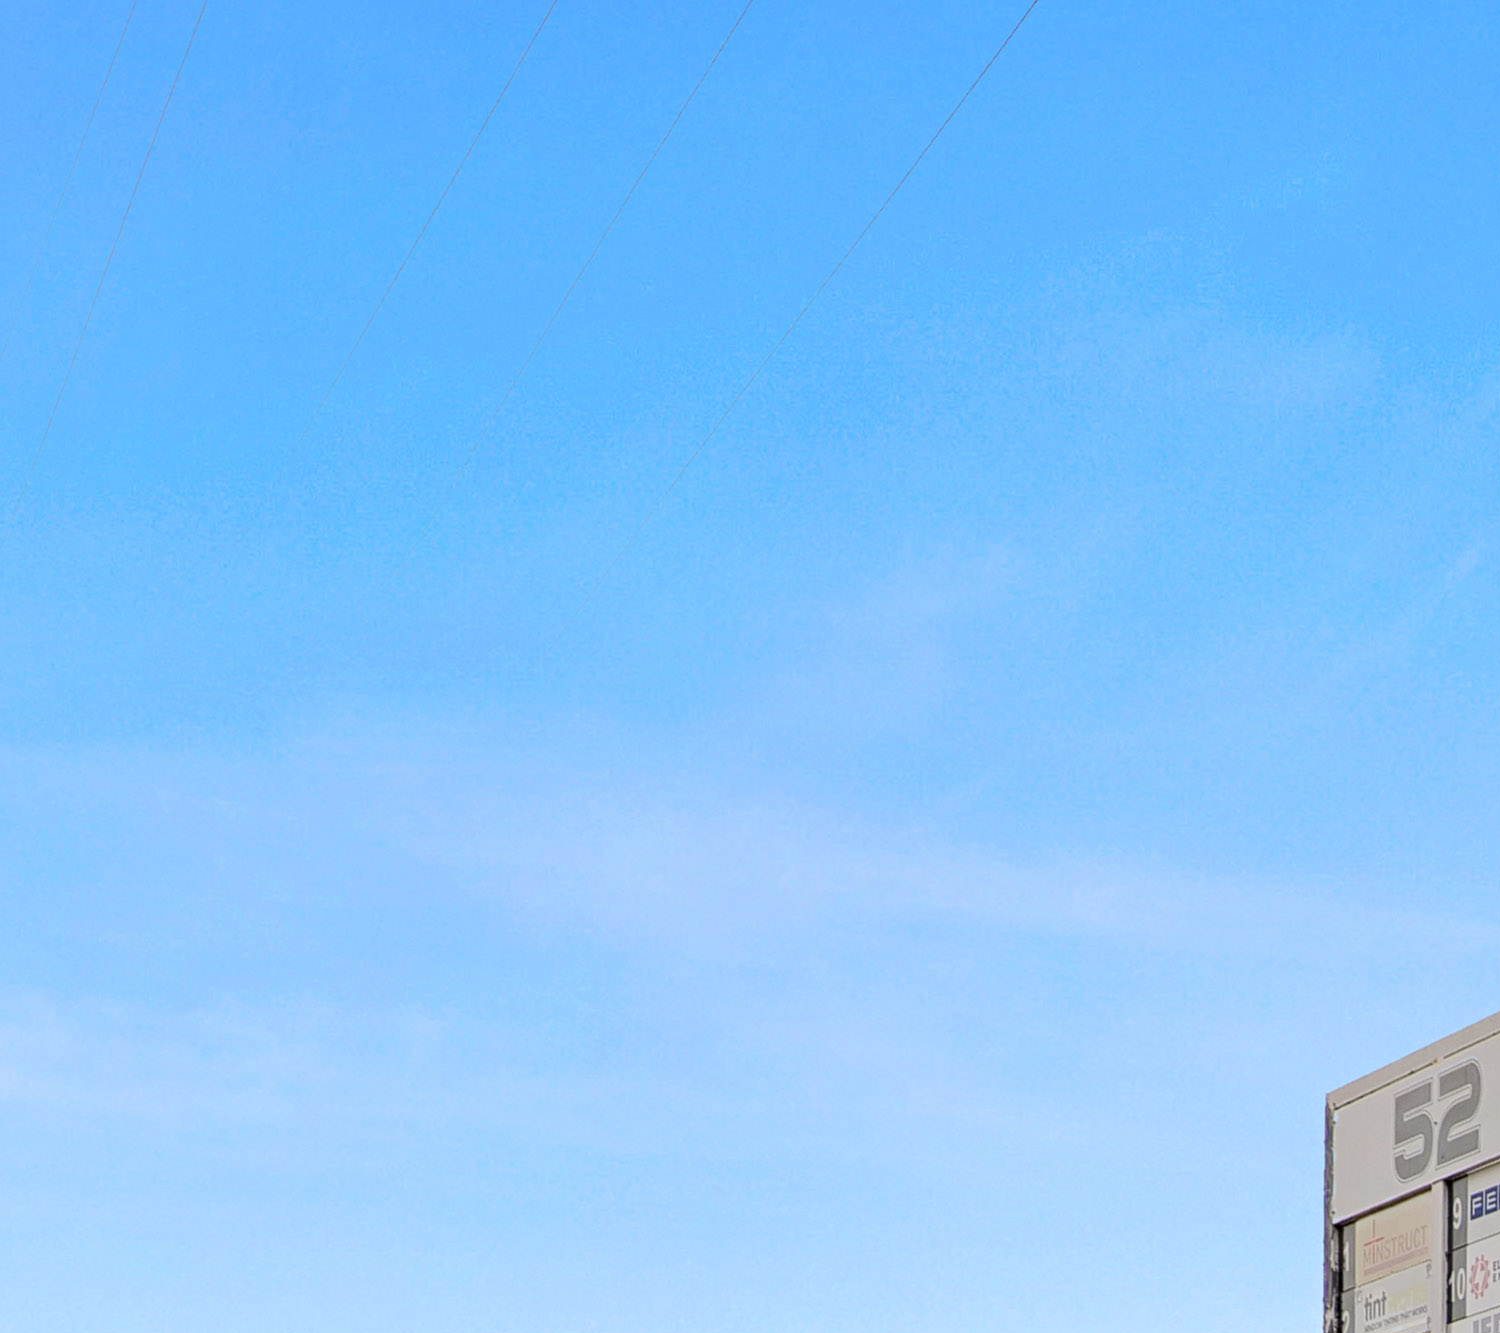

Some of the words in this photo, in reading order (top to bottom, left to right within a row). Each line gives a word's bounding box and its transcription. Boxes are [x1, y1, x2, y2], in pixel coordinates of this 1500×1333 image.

[1394, 1057, 1483, 1183] 52
[1452, 1197, 1463, 1230] 9
[1342, 1241, 1350, 1272] 1
[1448, 1268, 1466, 1303] 10
[1364, 1290, 1387, 1321] tint
